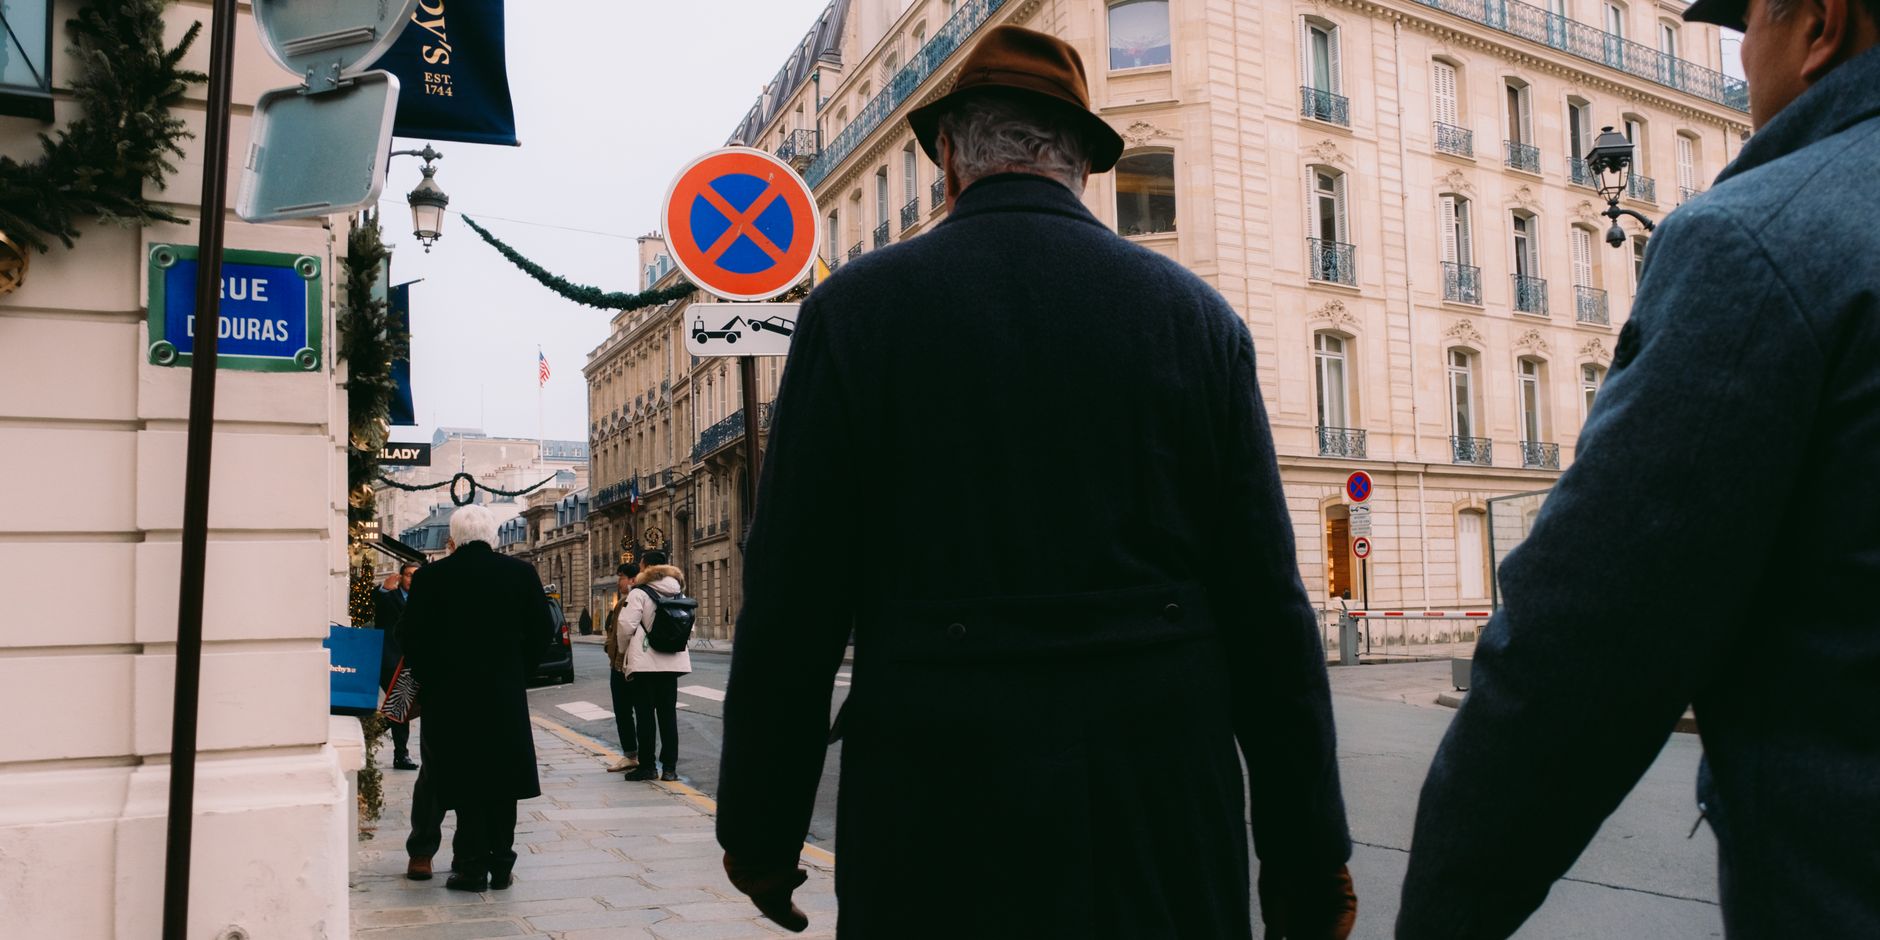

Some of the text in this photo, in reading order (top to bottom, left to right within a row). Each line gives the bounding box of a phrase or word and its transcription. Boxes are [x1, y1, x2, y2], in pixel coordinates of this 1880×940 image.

[424, 72, 453, 85] EST.
[425, 84, 453, 97] 1744
[220, 277, 268, 302] UE
[217, 316, 289, 342] DURAS
[376, 448, 420, 460] ILADY
